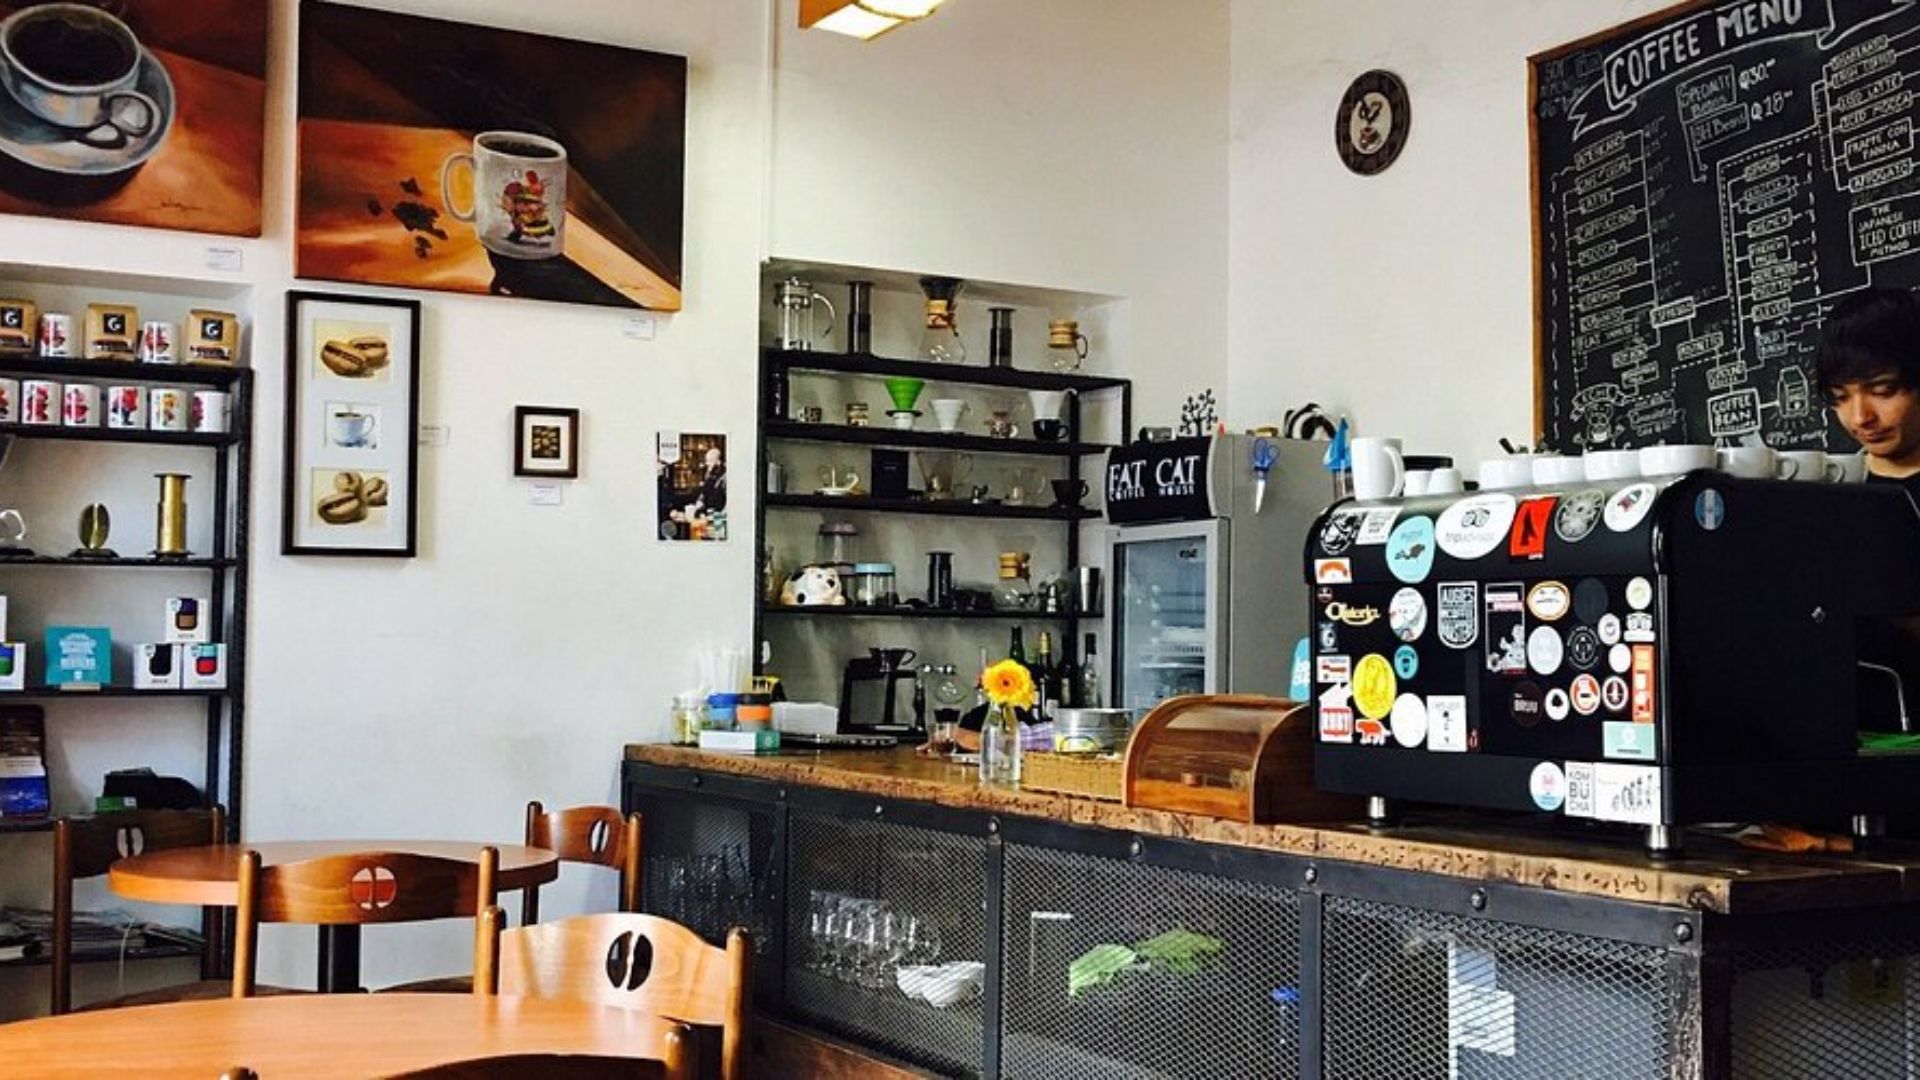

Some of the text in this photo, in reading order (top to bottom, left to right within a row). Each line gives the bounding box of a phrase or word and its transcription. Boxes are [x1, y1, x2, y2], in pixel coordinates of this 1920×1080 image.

[1609, 24, 1701, 99] COFFEE
[1717, 0, 1803, 46] MENU
[1859, 228, 1885, 250] ICED
[1109, 455, 1201, 492] FAT CAT
[1108, 483, 1195, 502] COFFEE HOUSE
